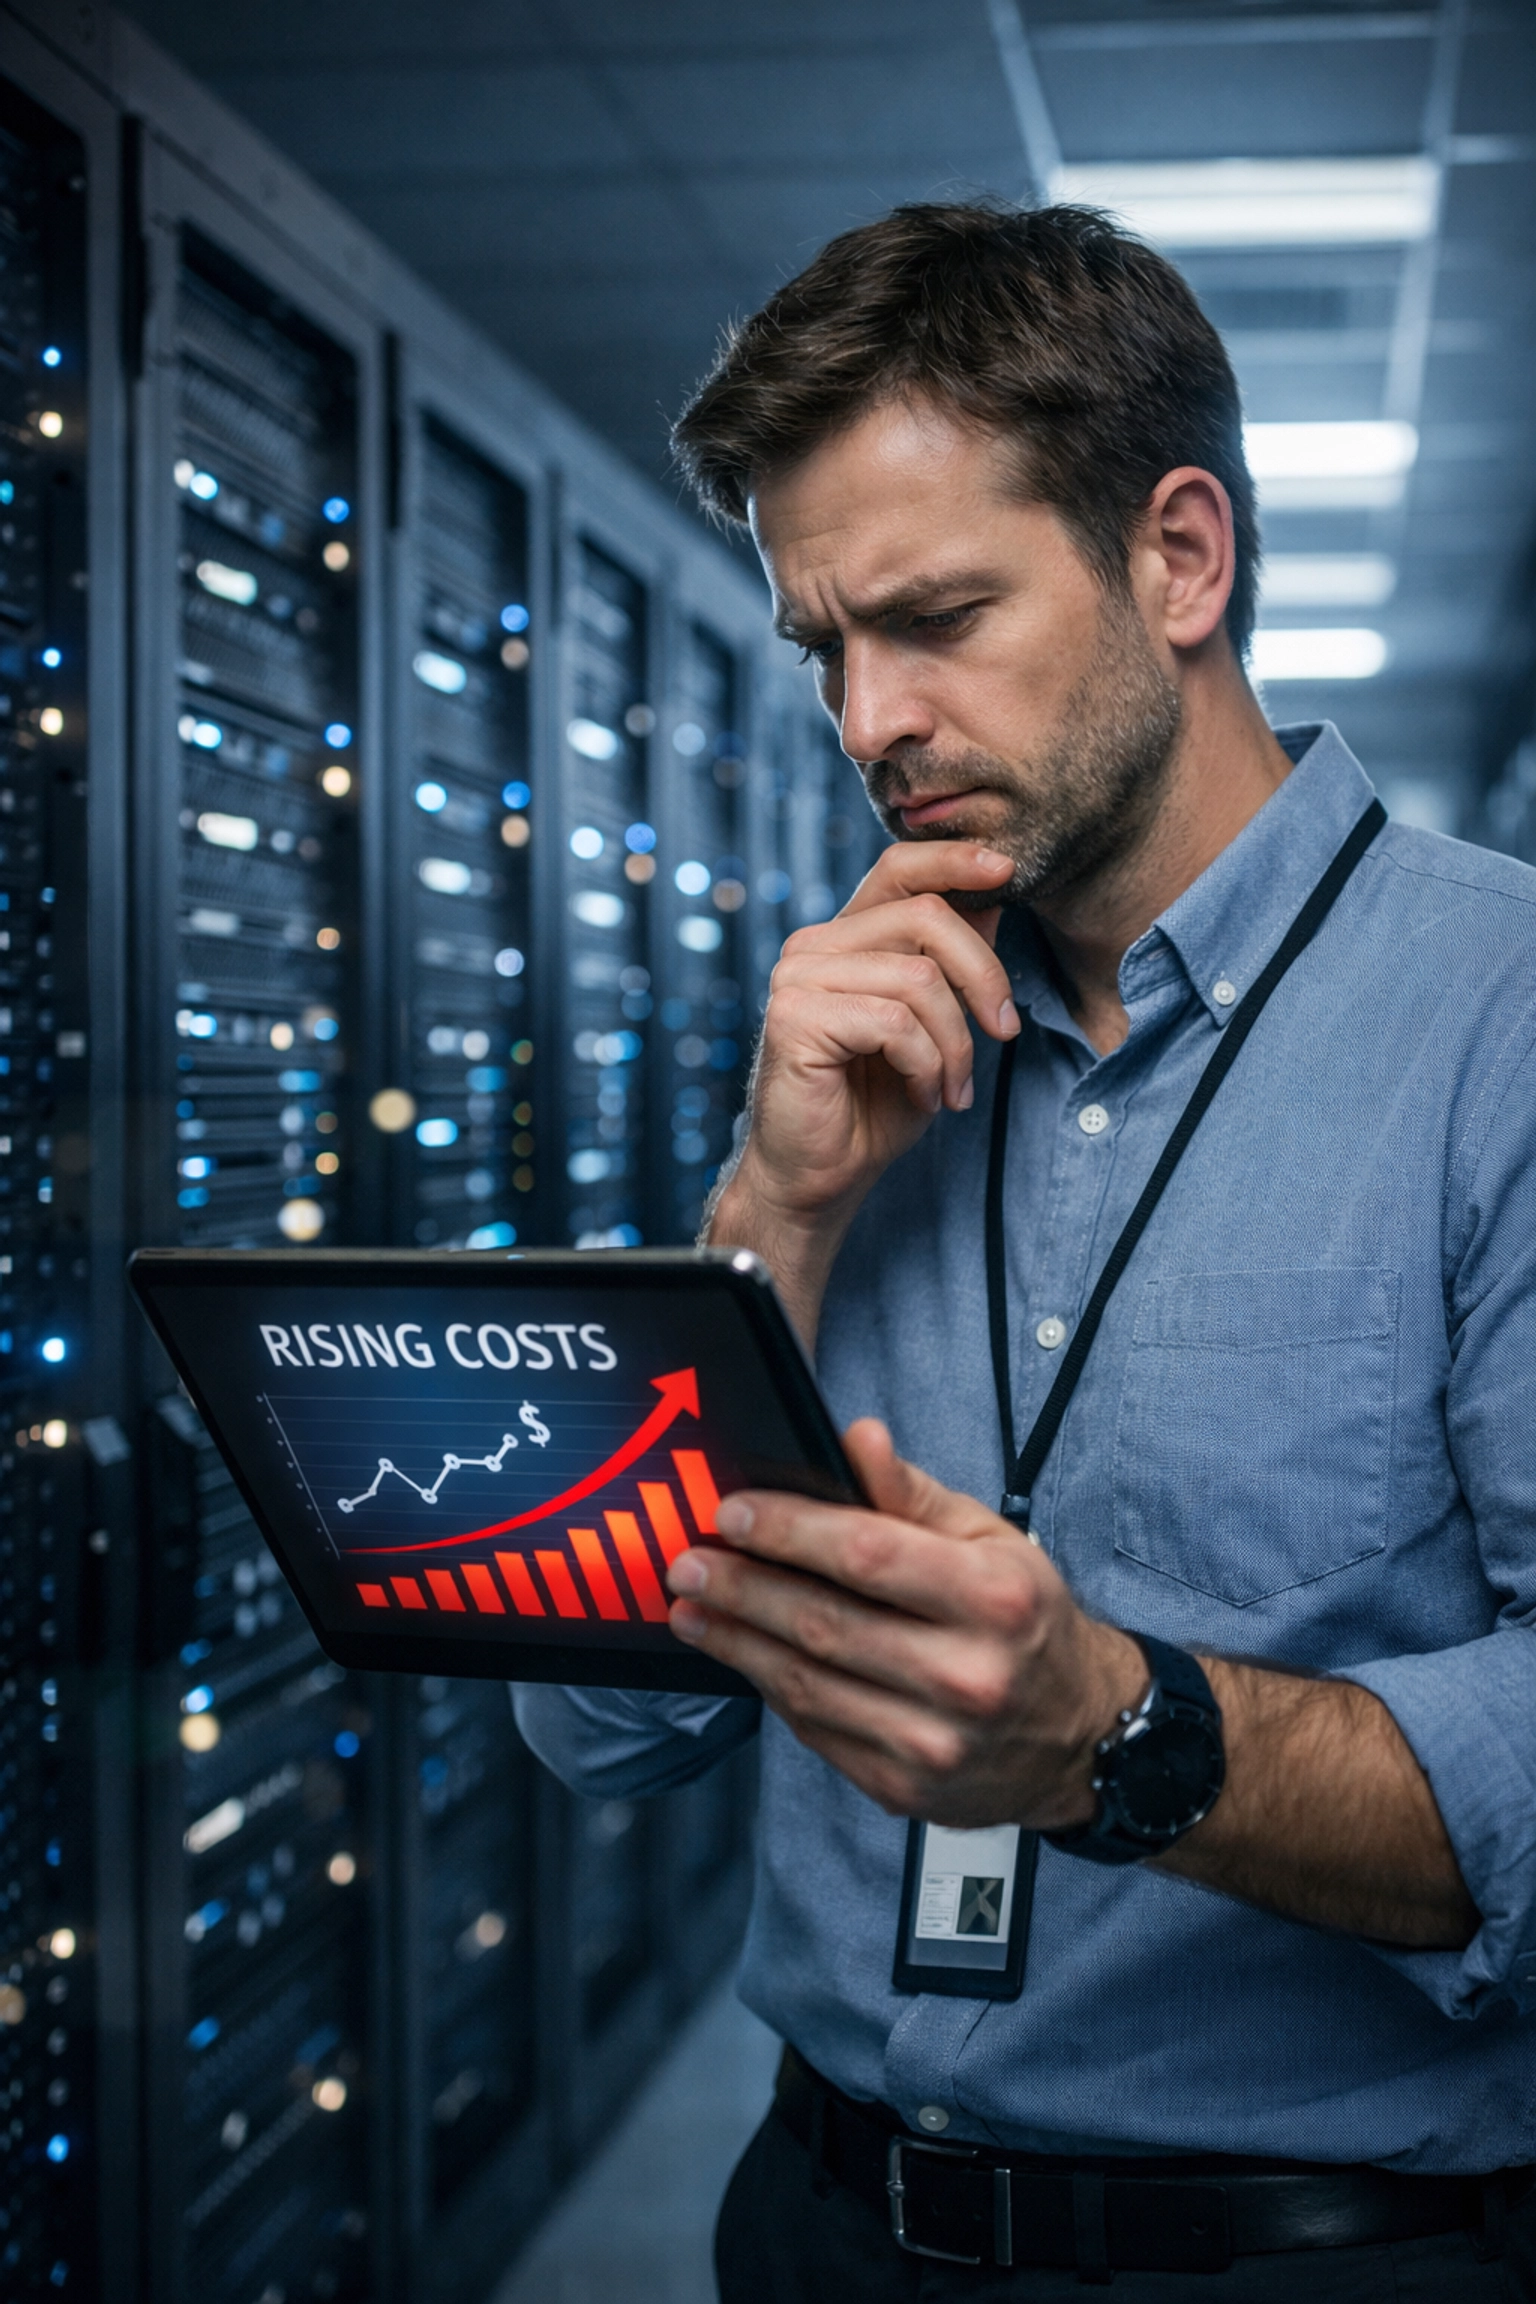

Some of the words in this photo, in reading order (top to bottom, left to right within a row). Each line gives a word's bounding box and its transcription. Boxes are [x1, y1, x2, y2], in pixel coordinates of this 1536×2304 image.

[259, 1323, 437, 1369] RISING
[445, 1323, 618, 1371] COSTS
[518, 1399, 552, 1448] $
